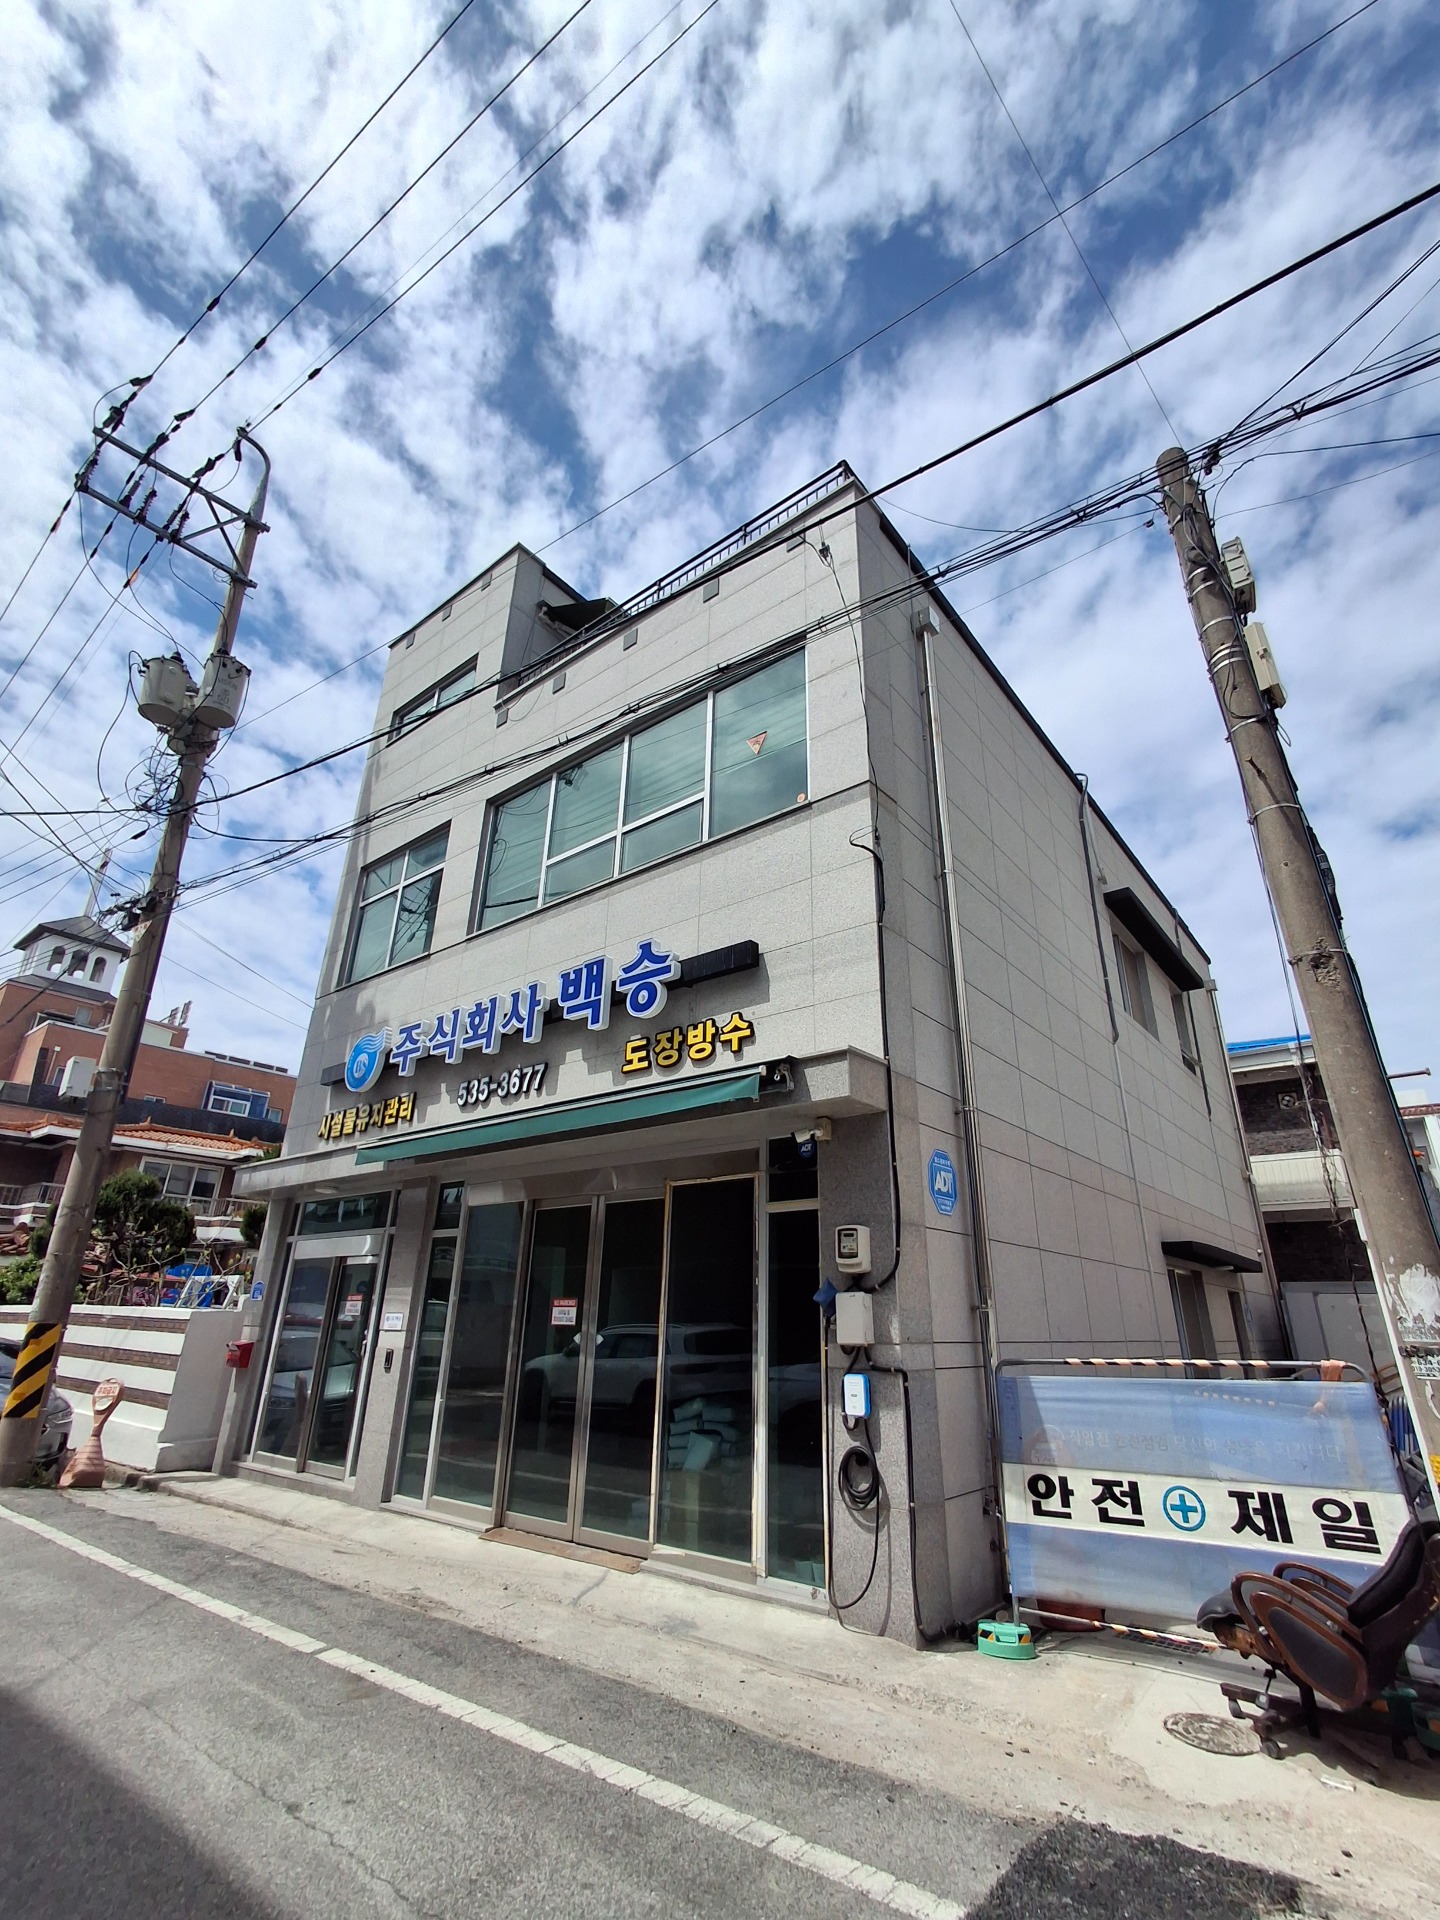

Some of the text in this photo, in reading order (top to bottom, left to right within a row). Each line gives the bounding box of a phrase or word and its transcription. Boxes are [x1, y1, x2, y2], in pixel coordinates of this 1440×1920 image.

[389, 938, 682, 1077] 주식회사 백승
[621, 1012, 755, 1074] 도장방수
[457, 1062, 548, 1107] 535-3677
[317, 1092, 416, 1140] 시설물유지관리
[934, 1170, 953, 1194] ADT
[1026, 1473, 1382, 1555] 안전 제일
